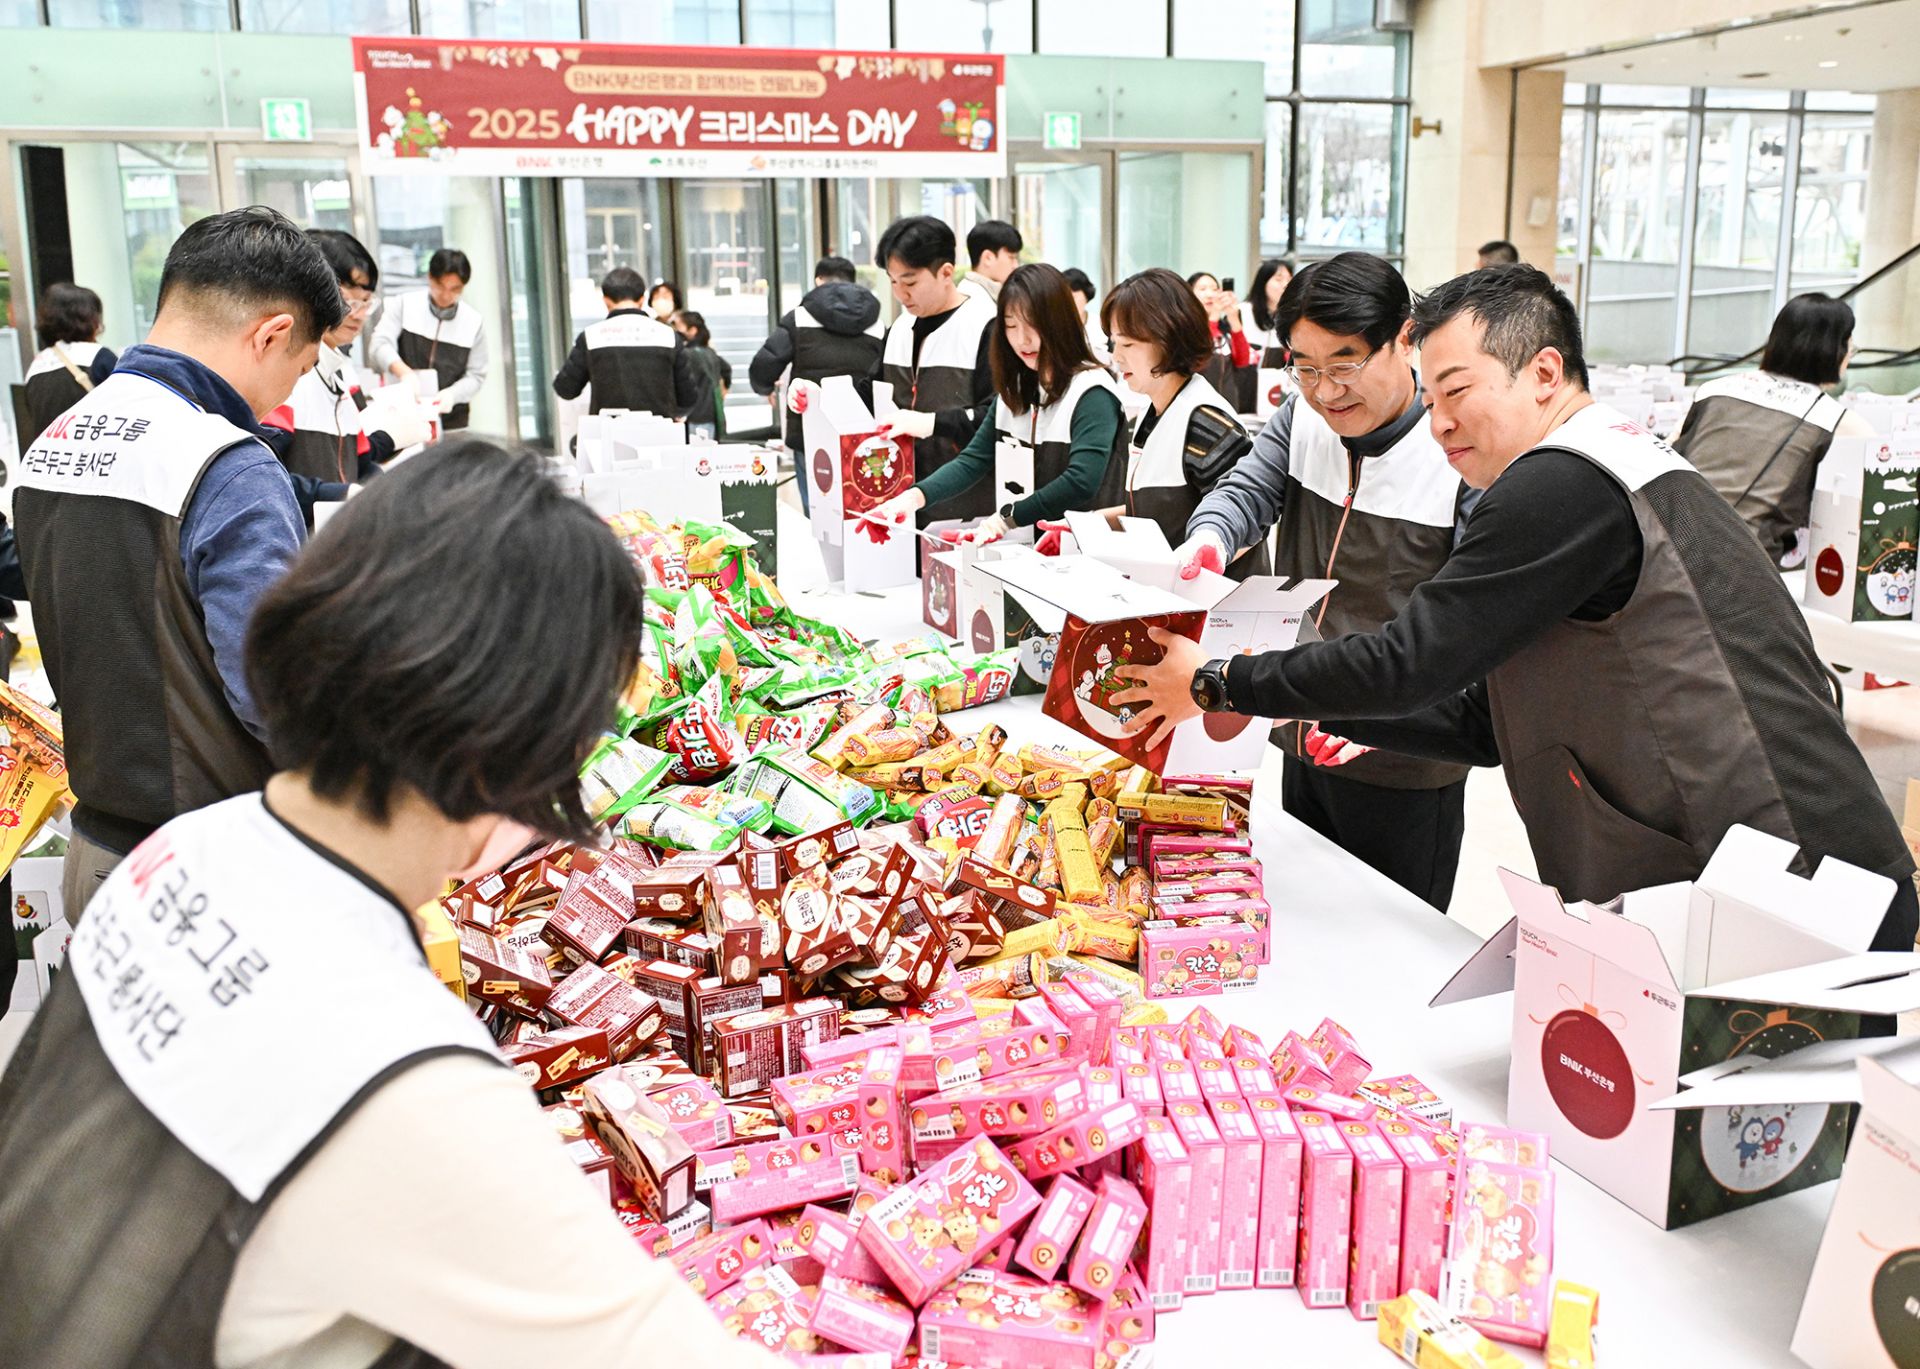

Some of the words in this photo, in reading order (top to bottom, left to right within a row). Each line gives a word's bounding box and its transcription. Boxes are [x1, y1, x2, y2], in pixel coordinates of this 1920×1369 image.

[467, 107, 561, 140] 2025
[566, 102, 695, 146] HAPPY
[699, 110, 840, 144] 크리스마스
[847, 107, 918, 149] DAY
[74, 414, 151, 442] 금융그룹
[73, 450, 117, 477] 봉사단
[678, 704, 720, 769] 포카칩
[796, 890, 816, 927] 초코하임
[150, 867, 270, 1007] 금융그룹
[507, 930, 541, 951] 코하임
[1185, 953, 1220, 975] 칸쵸
[1559, 1053, 1584, 1076] BNK
[1583, 1068, 1616, 1093] 부산은행
[832, 1107, 851, 1121] 칸쵸
[962, 1171, 1008, 1208] 칸쵸
[991, 1293, 1042, 1318] 칸쵸
[751, 1309, 788, 1348] 칸쵸
